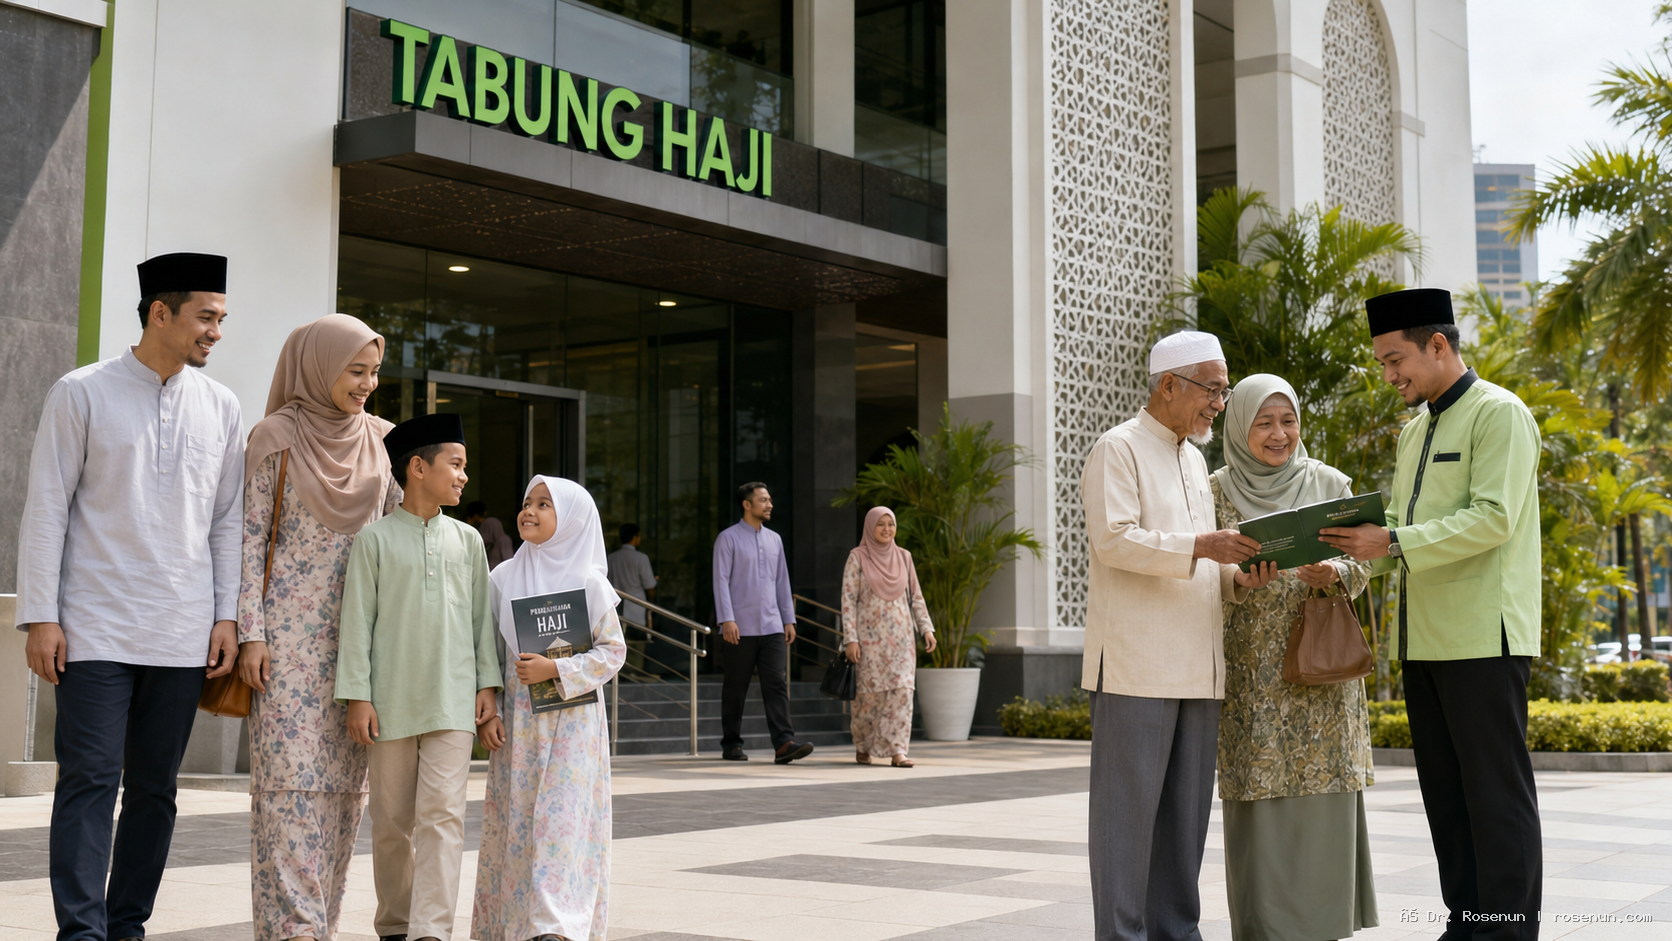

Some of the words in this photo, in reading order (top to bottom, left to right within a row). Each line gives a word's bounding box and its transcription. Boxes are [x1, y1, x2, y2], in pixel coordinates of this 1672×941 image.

[387, 18, 644, 160] TABUNG
[662, 101, 772, 197] HAJI
[537, 613, 568, 633] HAJI
